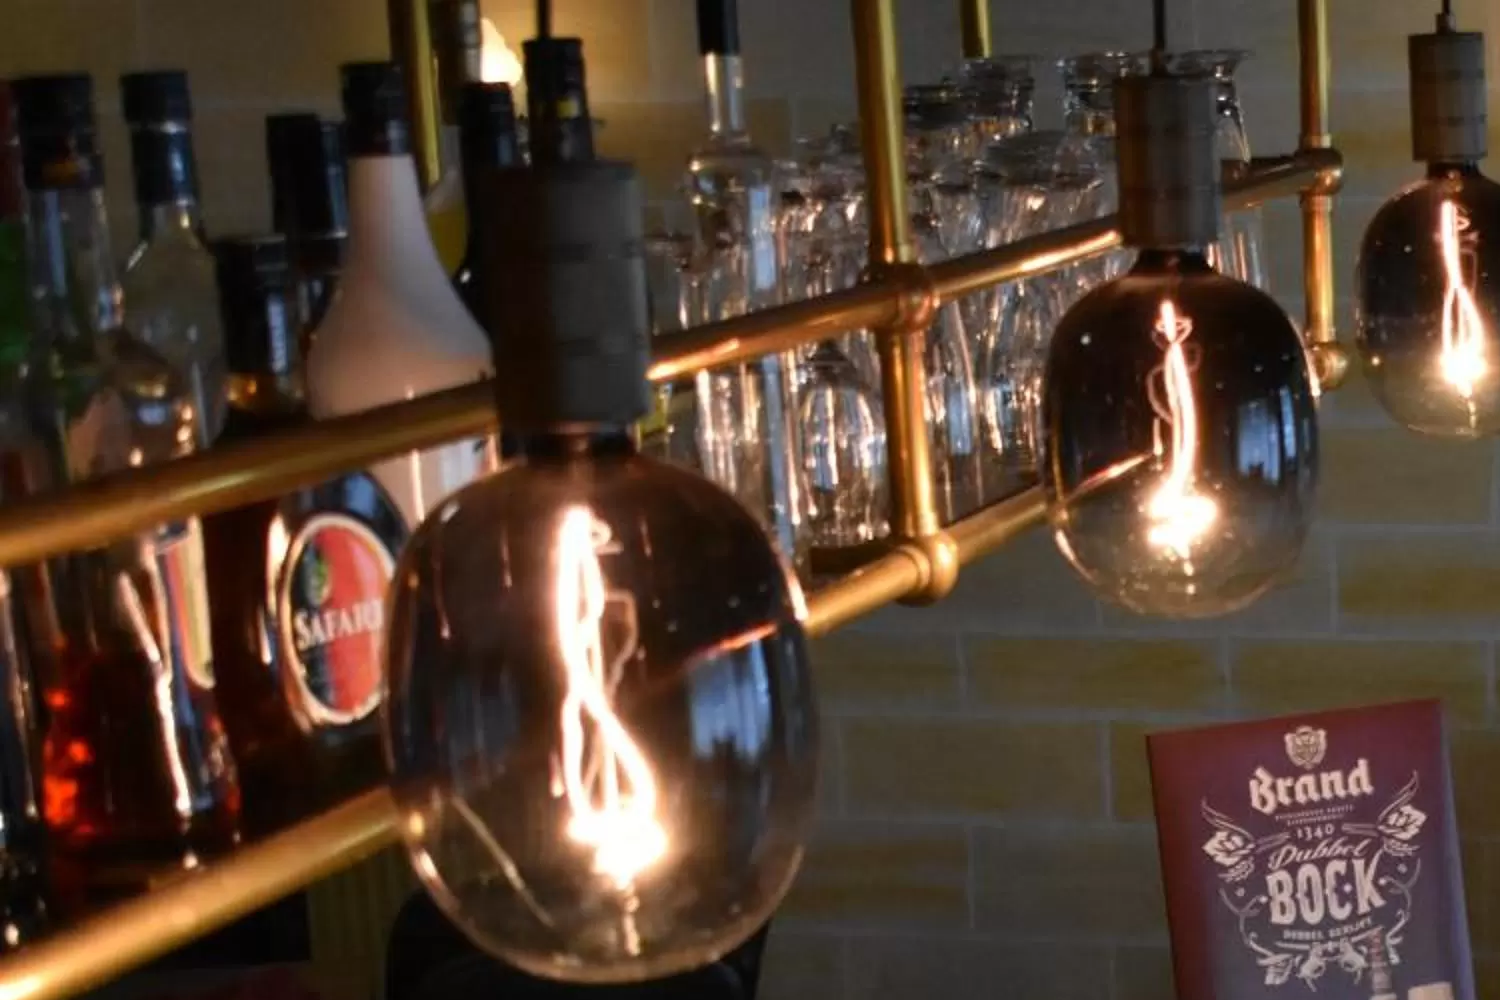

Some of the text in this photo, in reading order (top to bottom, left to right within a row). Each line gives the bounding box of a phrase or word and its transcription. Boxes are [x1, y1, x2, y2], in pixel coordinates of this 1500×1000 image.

[1249, 757, 1375, 816] Brand
[1267, 836, 1373, 870] Dubbel
[1296, 823, 1336, 841] 1340
[1265, 848, 1387, 925] BOCK
